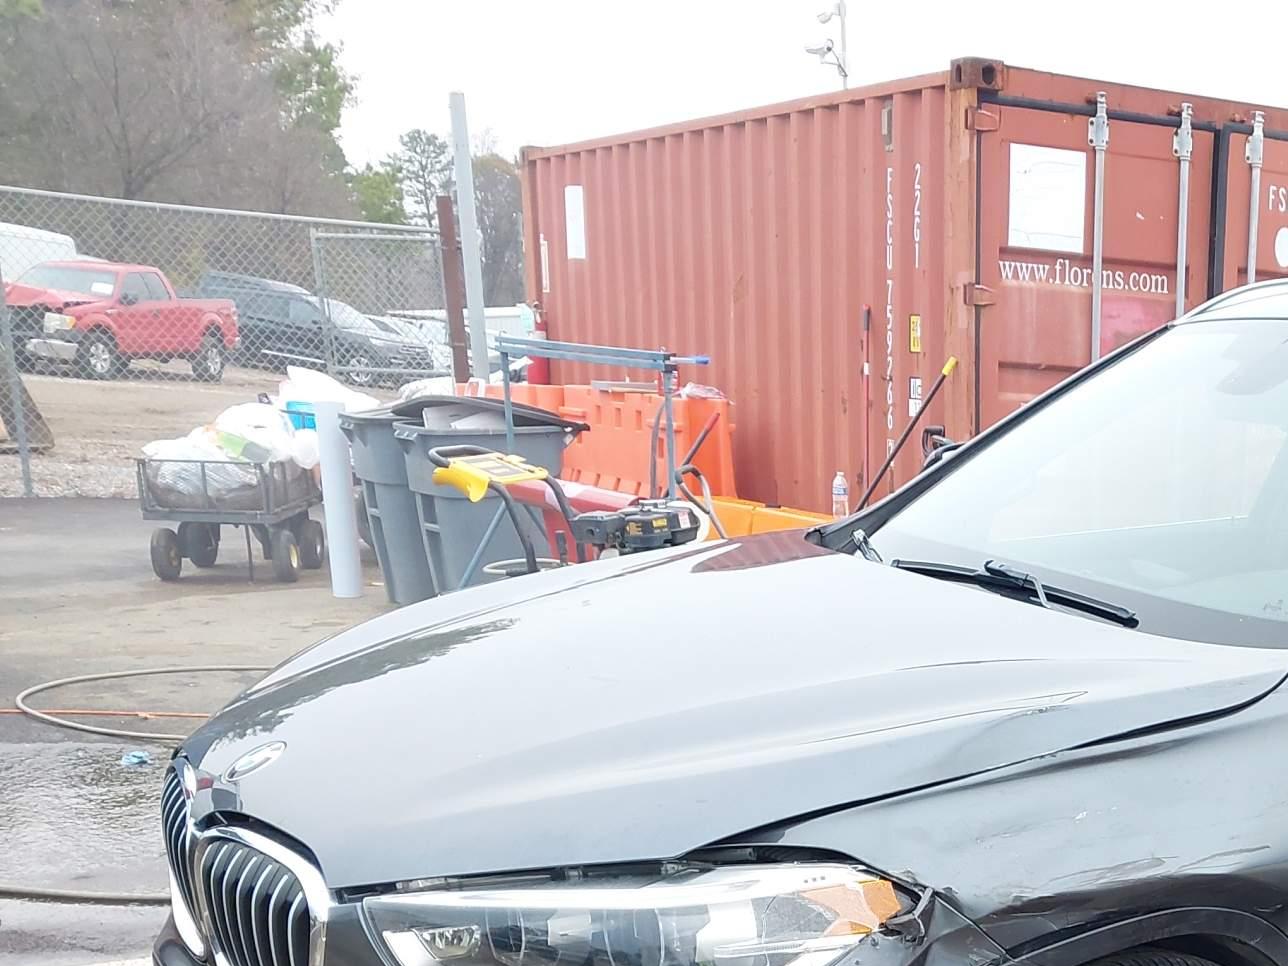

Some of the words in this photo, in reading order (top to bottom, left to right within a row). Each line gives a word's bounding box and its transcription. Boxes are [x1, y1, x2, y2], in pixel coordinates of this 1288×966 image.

[913, 162, 921, 269] 22G1
[998, 258, 1169, 294] www.florns.com
[886, 279, 894, 430] 759266
